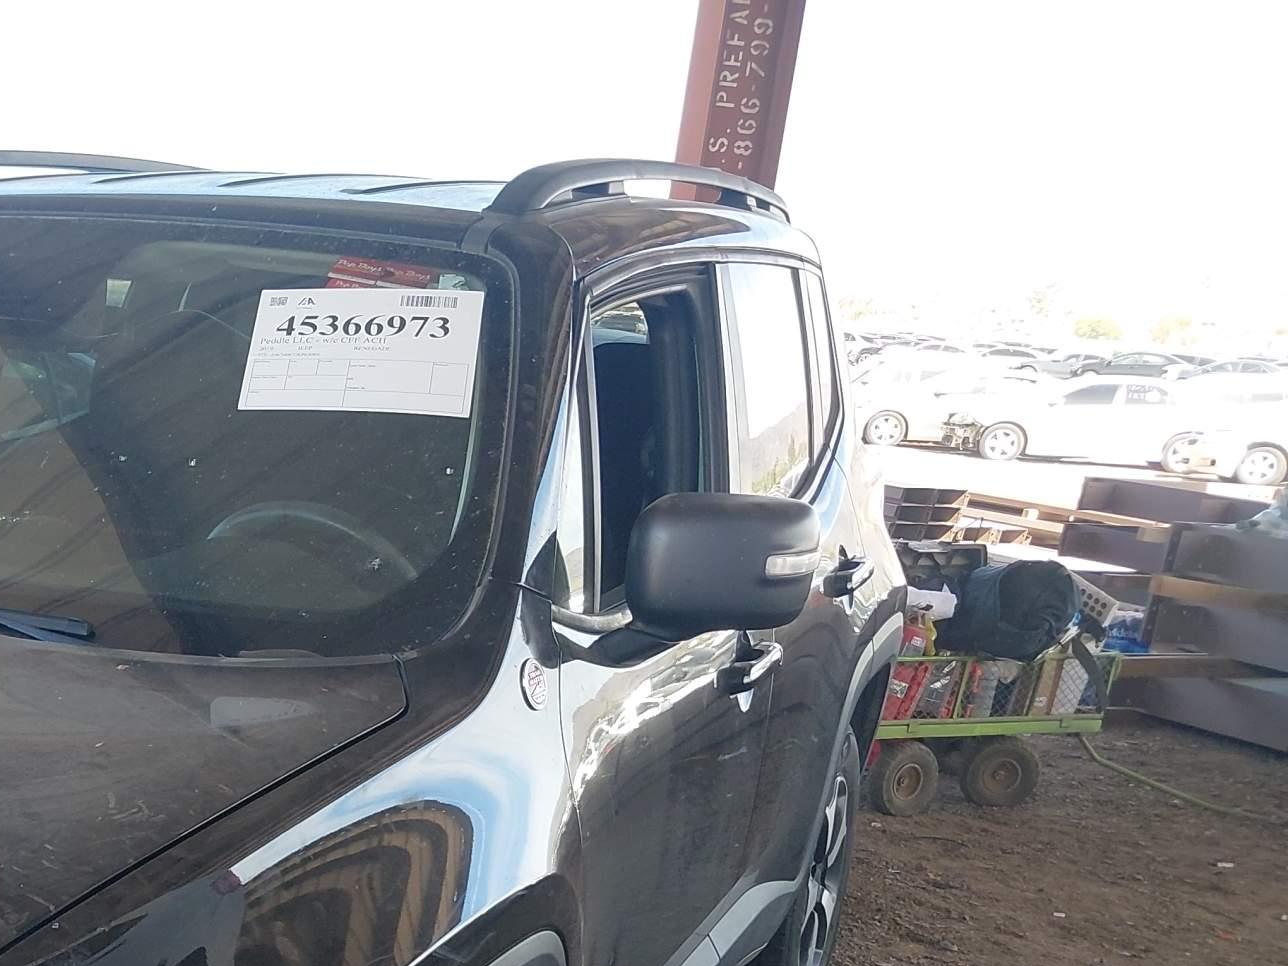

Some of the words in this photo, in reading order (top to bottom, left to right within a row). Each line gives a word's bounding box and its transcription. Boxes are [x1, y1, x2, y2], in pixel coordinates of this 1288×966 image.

[715, 0, 751, 108] PREFA
[733, 3, 774, 169] -866-799-
[260, 336, 290, 345] Peddle
[292, 336, 314, 345] LLC
[275, 313, 450, 339] 45366973
